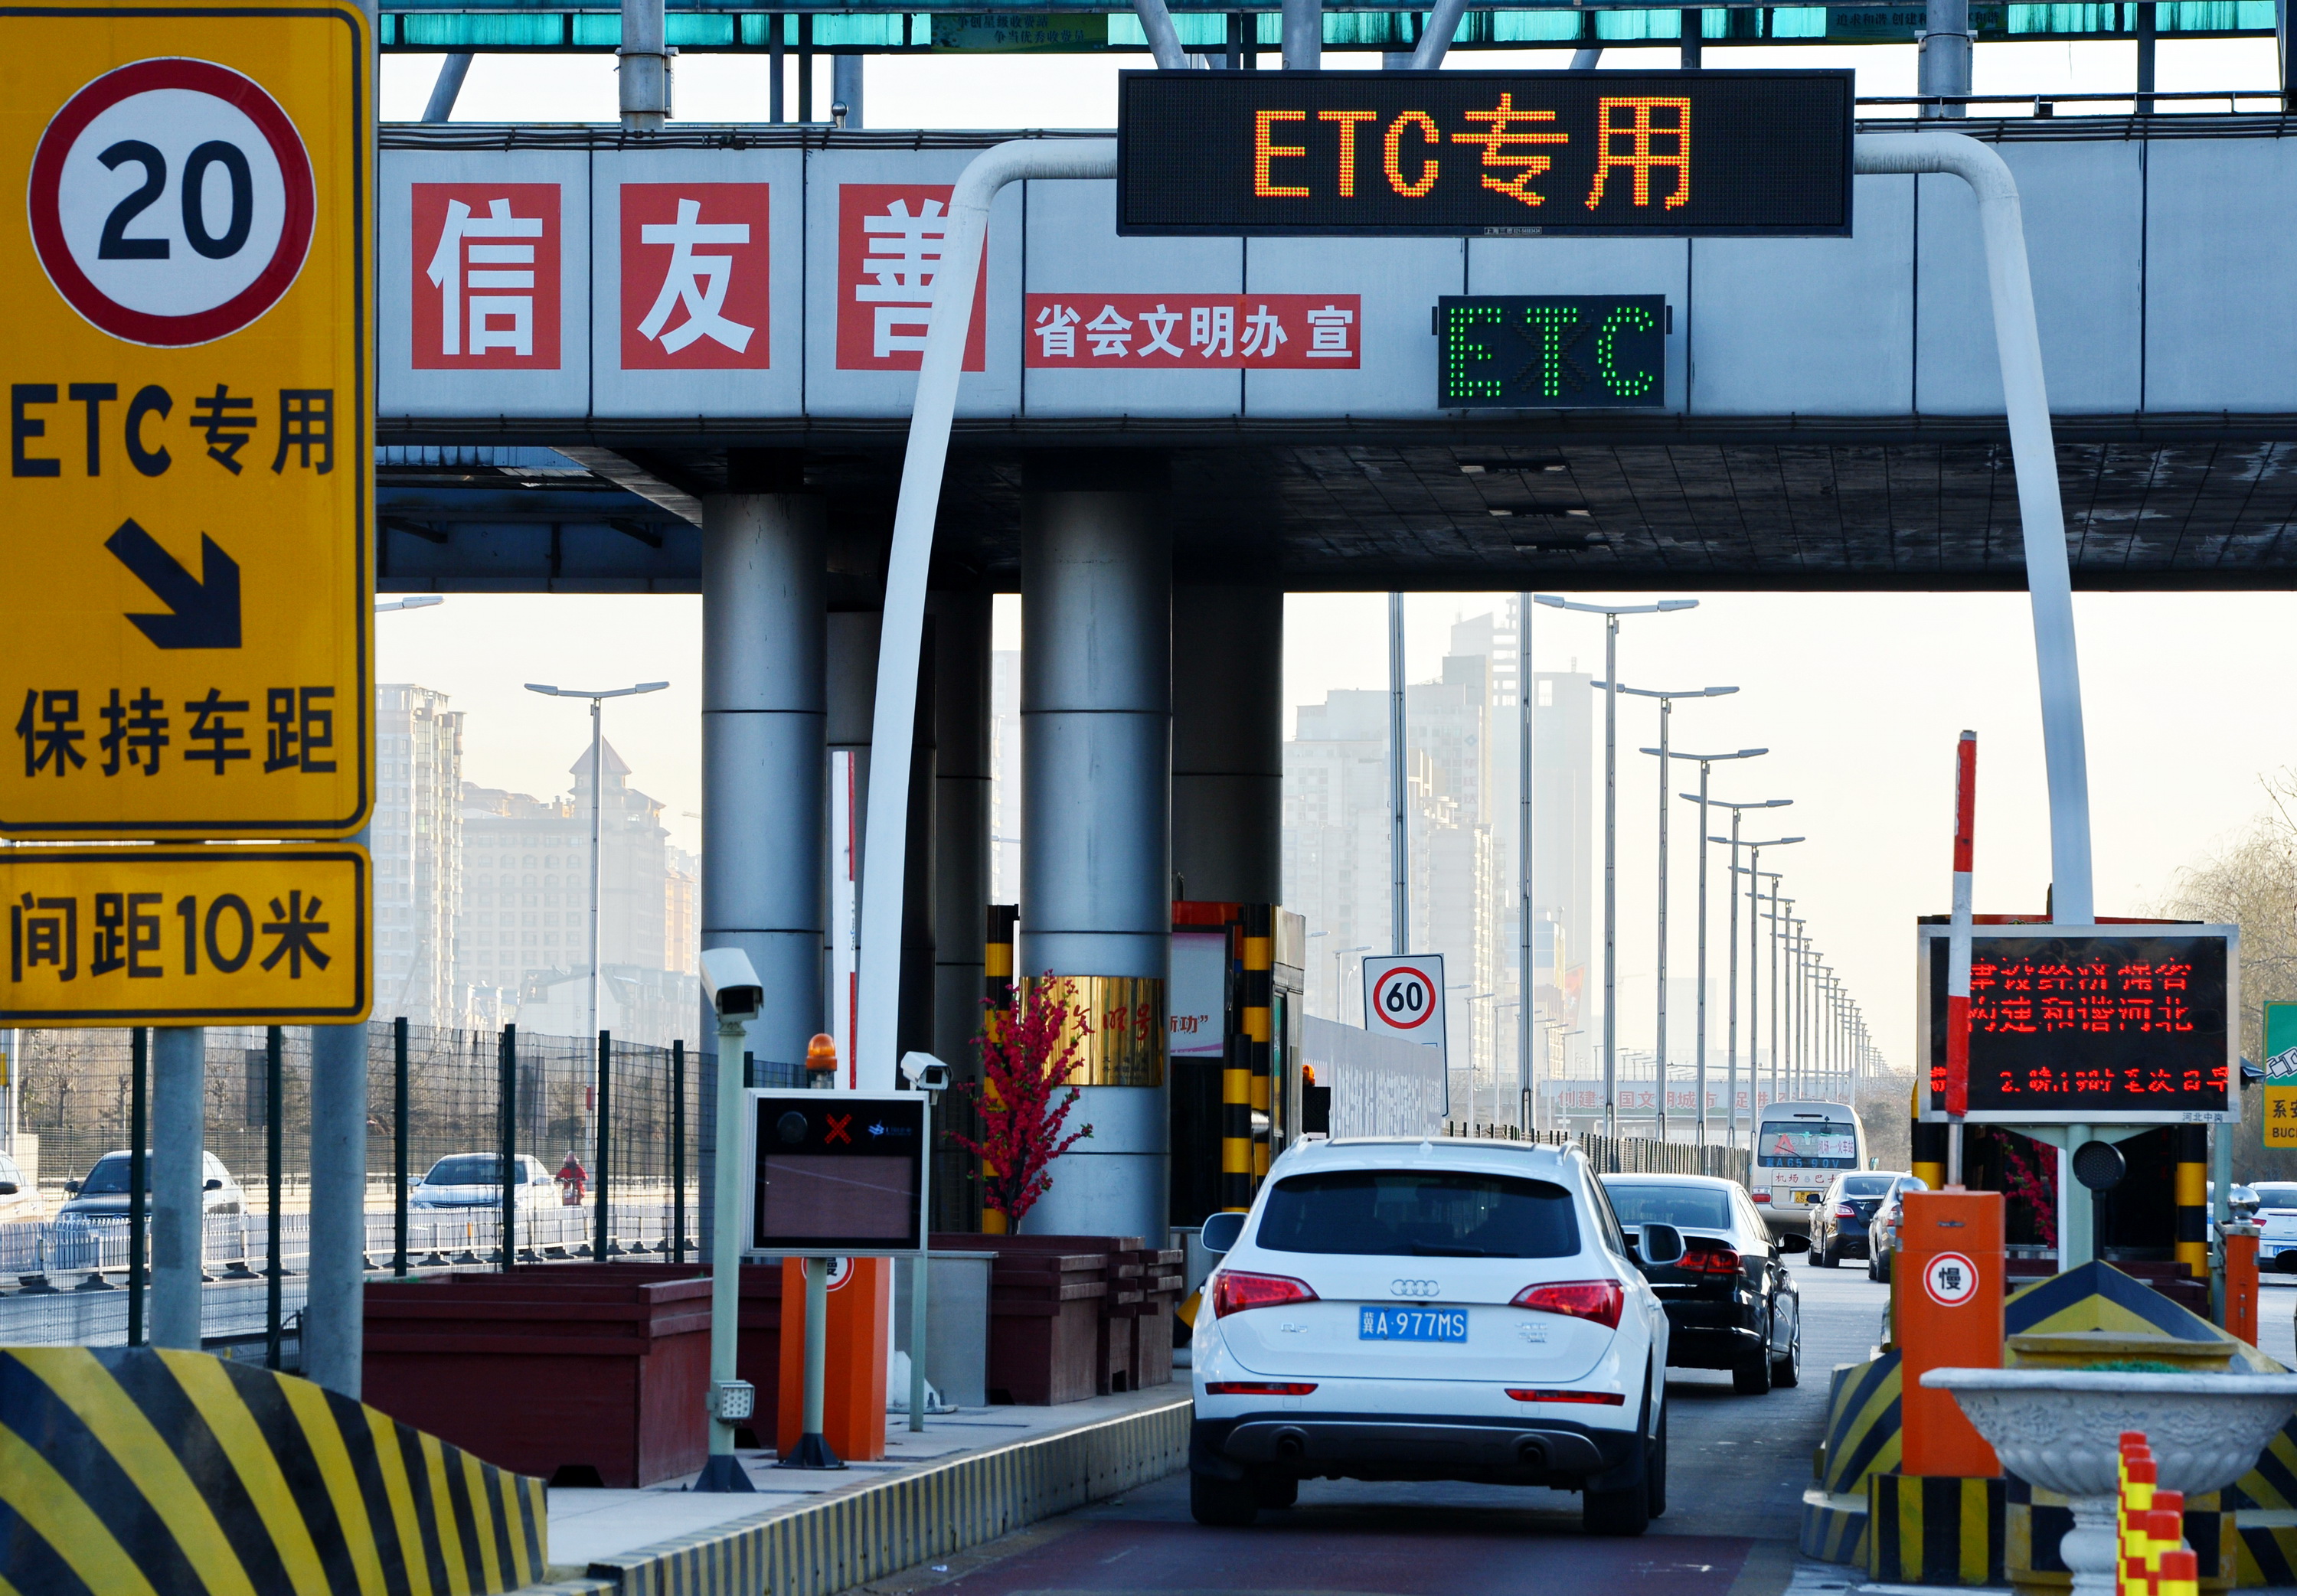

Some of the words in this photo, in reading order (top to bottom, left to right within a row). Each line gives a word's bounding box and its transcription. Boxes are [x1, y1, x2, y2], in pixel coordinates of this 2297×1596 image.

[958, 15, 1048, 28] 争创星级收费站
[995, 30, 1085, 43] 争当优秀收费员
[1836, 12, 1887, 25] 追求和谐
[1255, 93, 1691, 211] ETC专用
[96, 139, 253, 260] 20
[426, 198, 543, 356] 信
[637, 198, 755, 355] 友
[1034, 304, 1289, 359] 省会文明办
[1306, 305, 1353, 357] 宣
[1450, 308, 1654, 397] ETC
[11, 383, 334, 478] ETC专用
[15, 687, 337, 778] 保持车距
[11, 890, 332, 983] 间距10米
[1386, 982, 1423, 1012] 60
[2272, 1128, 2297, 1138] BUC
[1776, 1172, 1799, 1183] 机场
[1939, 1267, 1961, 1291] 慢
